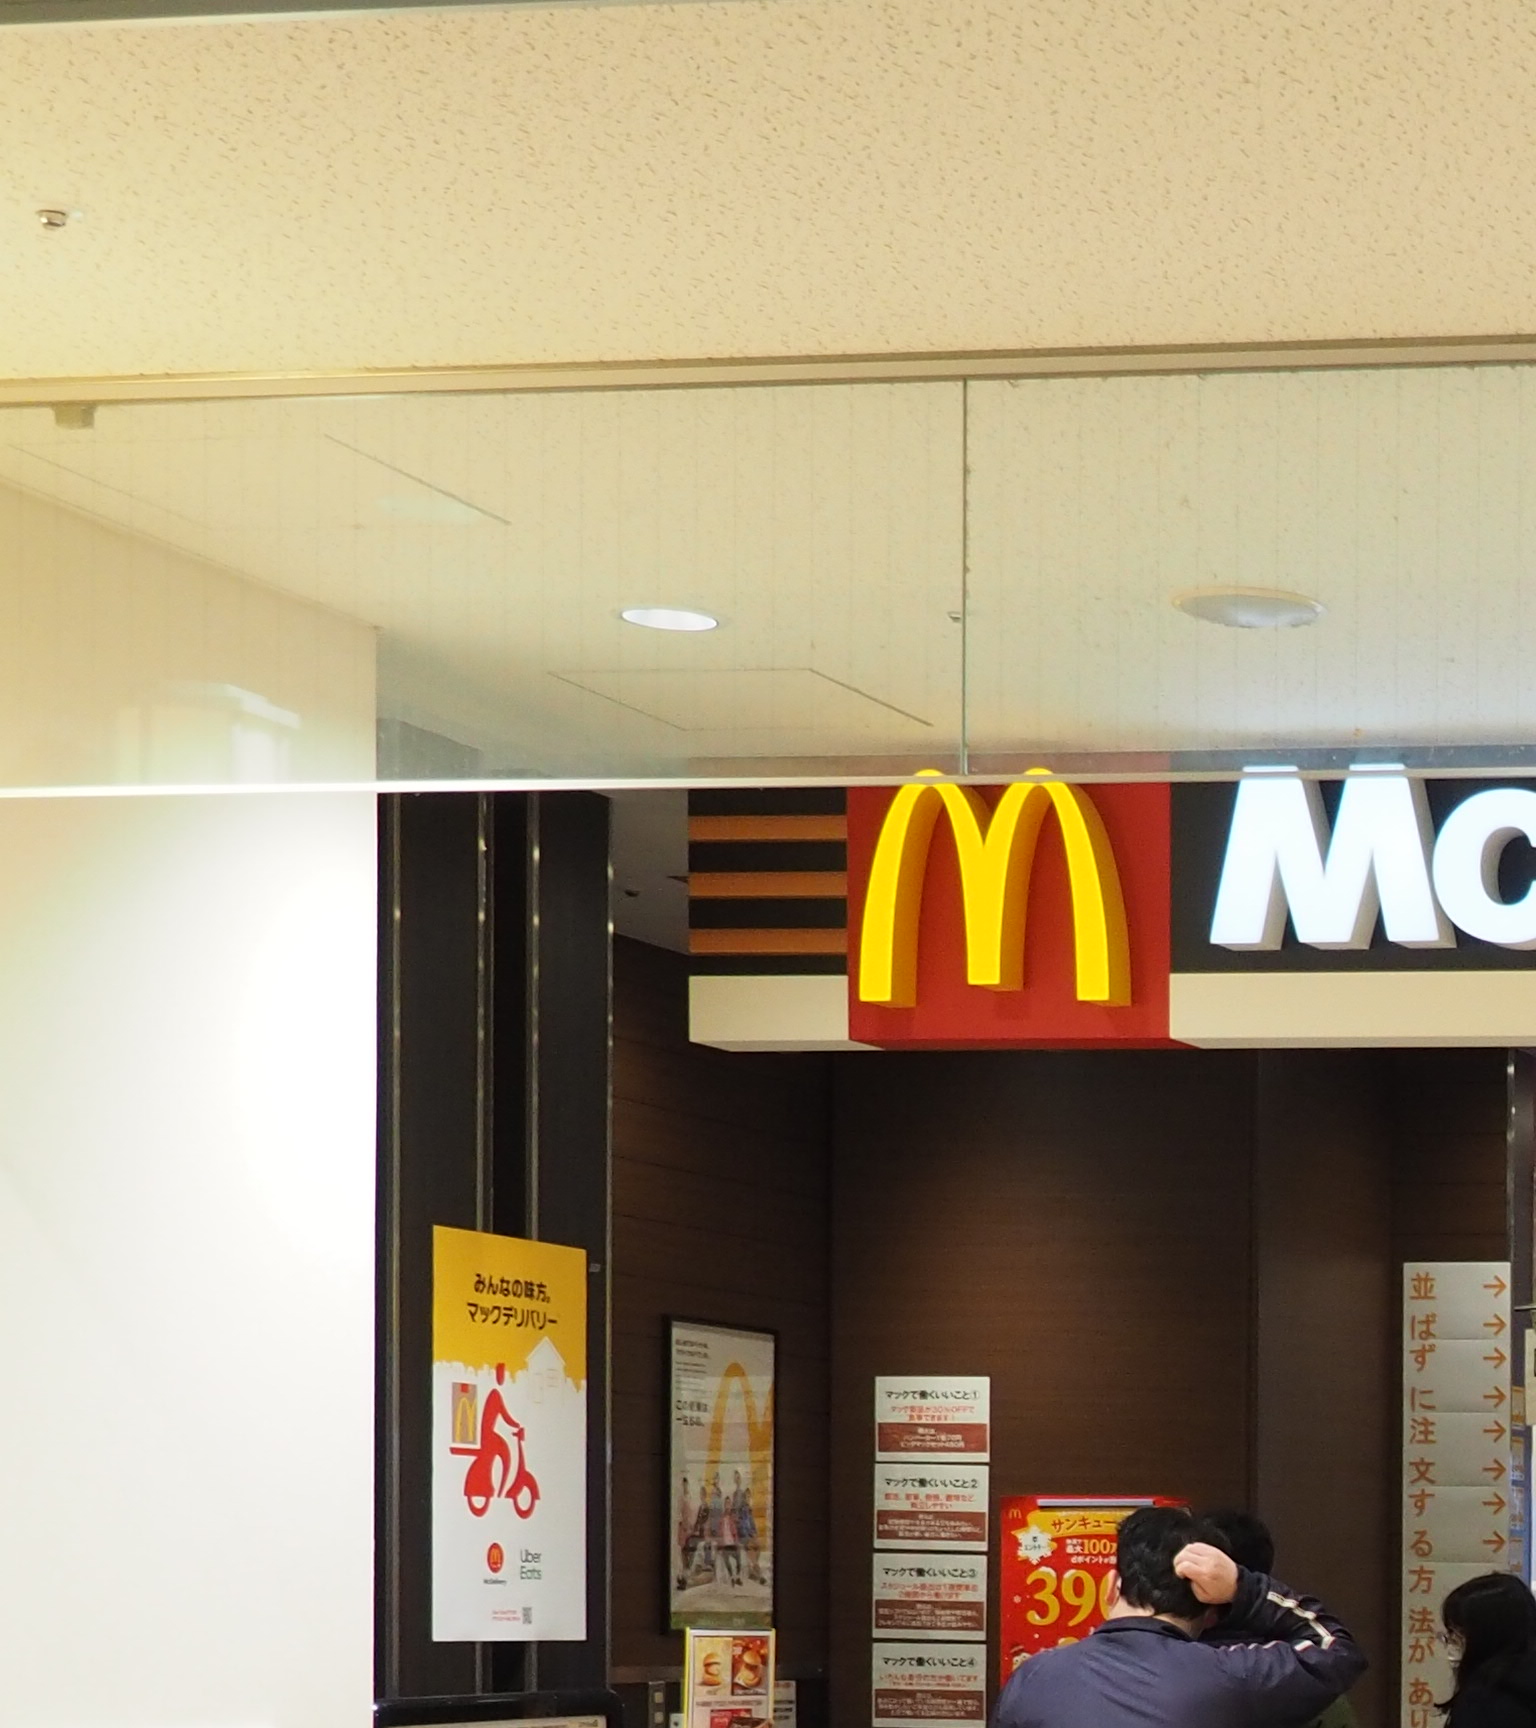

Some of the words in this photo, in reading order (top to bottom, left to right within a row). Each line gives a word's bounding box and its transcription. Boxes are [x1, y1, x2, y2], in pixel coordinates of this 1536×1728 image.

[473, 1272, 552, 1304] みんなの味方。
[466, 1301, 558, 1331] マックデリバリー
[1051, 1515, 1117, 1534] サンキュー
[520, 1549, 542, 1563] Uber
[520, 1565, 542, 1580] Eats
